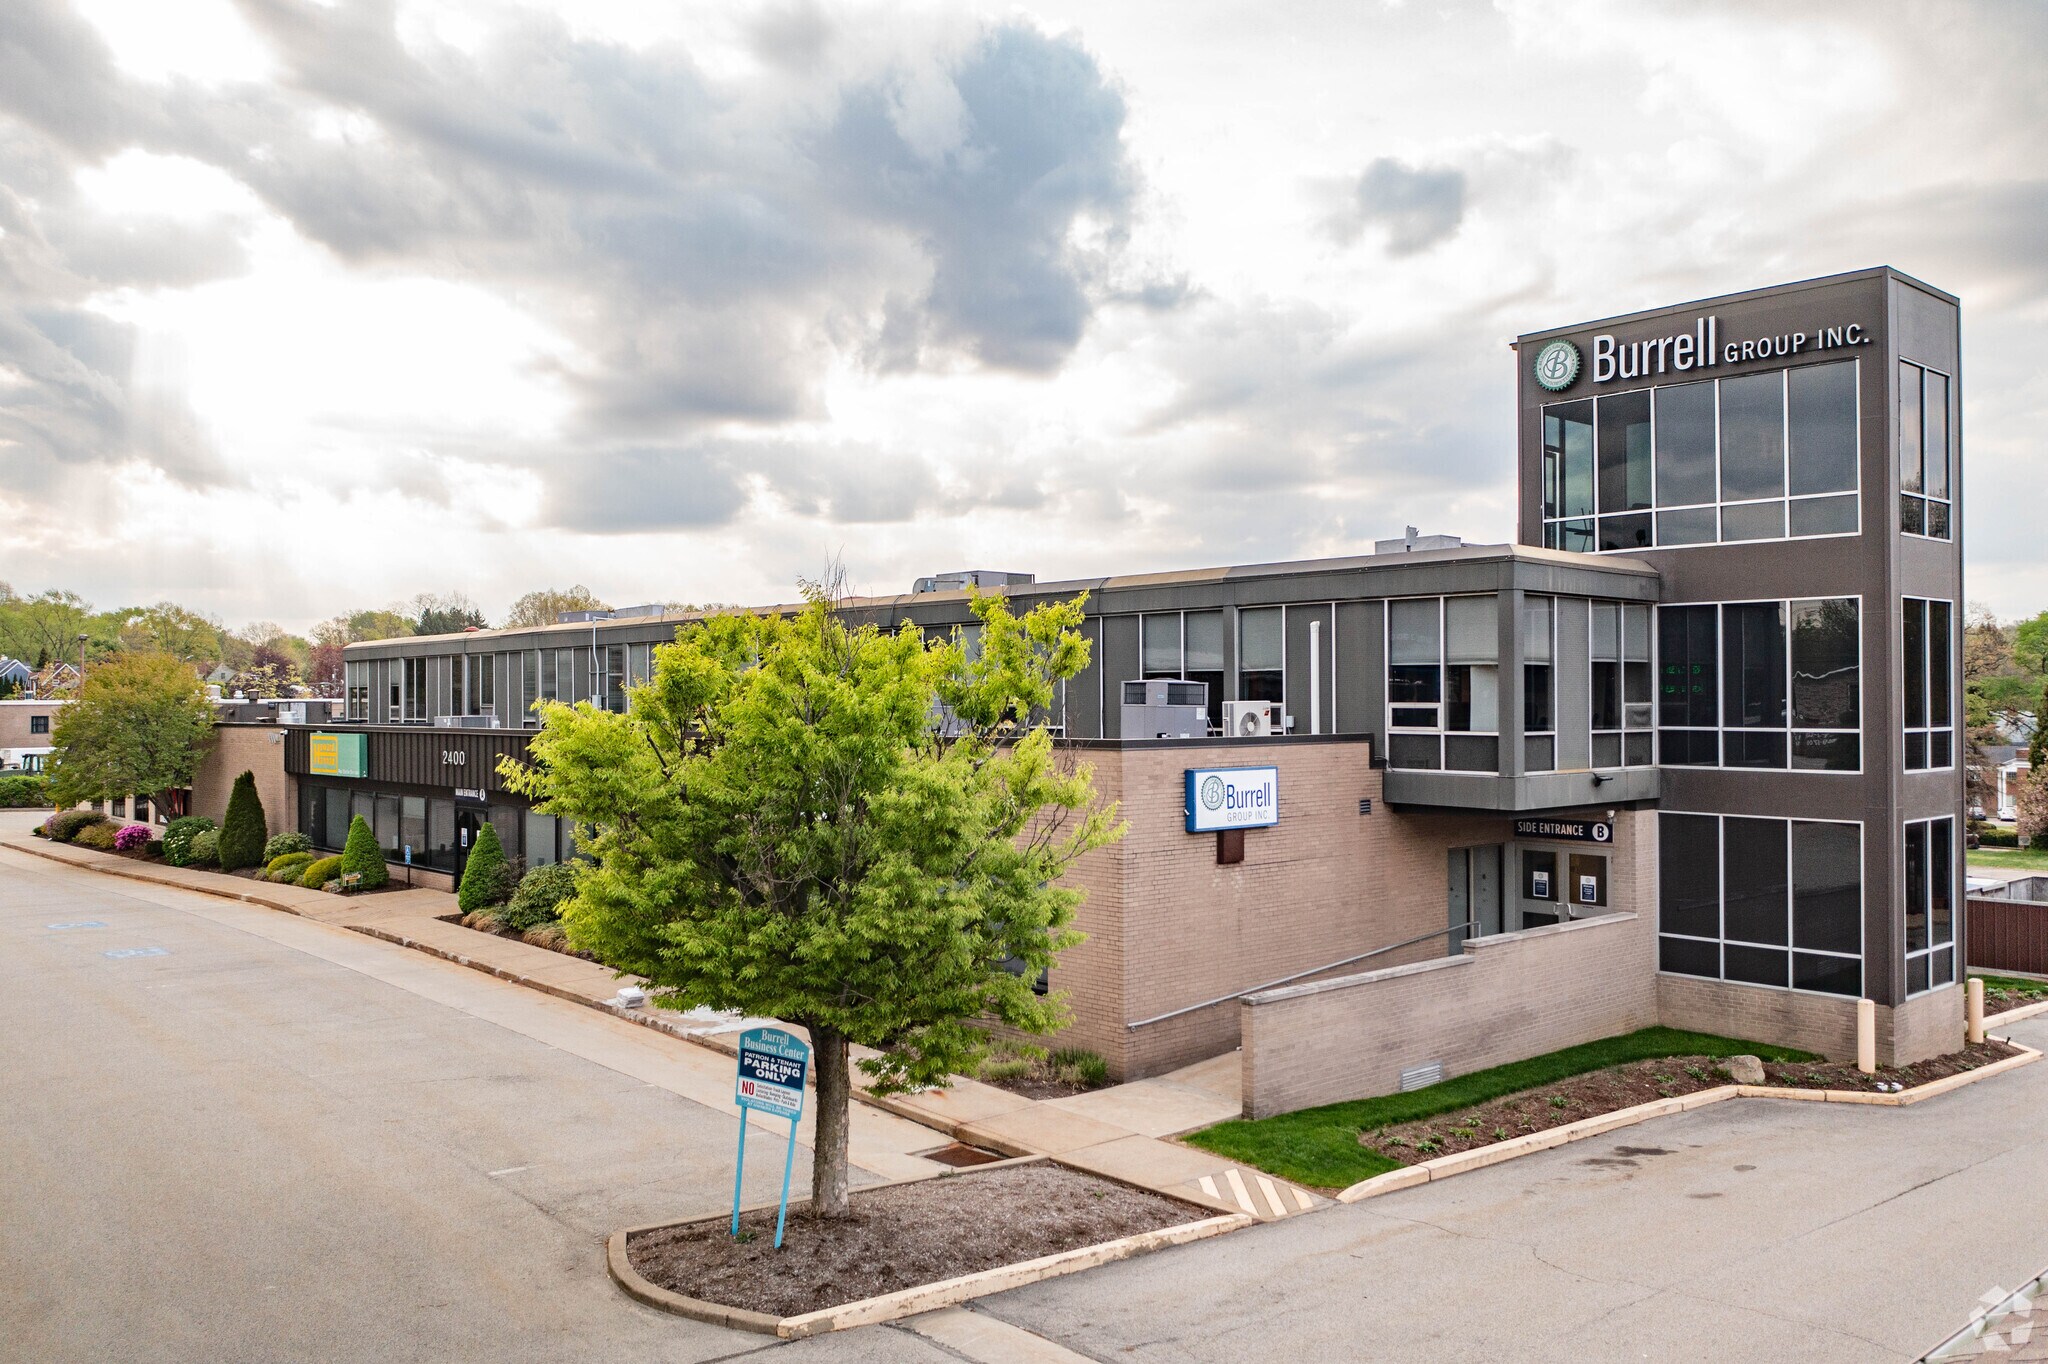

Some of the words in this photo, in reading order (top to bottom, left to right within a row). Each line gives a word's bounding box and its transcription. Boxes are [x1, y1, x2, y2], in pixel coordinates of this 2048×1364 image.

[1593, 315, 1716, 383] Burrell
[1724, 332, 1806, 363] GROUP
[1818, 323, 1870, 349] INC.
[442, 750, 465, 766] 2400
[463, 788, 479, 798] ENTRANCE
[1226, 782, 1271, 810] Burrell
[1227, 811, 1253, 822] GROUP
[1255, 810, 1270, 820] INC.
[1517, 821, 1537, 833] SIDE
[1539, 823, 1584, 836] ENTRANCE
[1596, 825, 1605, 839] B
[761, 1029, 790, 1045] Burrell
[744, 1036, 777, 1053] Business
[778, 1044, 804, 1060] Center
[743, 1057, 801, 1078] PARKING
[744, 1051, 770, 1062] PATRON
[777, 1058, 801, 1069] TENANT
[755, 1069, 788, 1083] ONLY
[741, 1080, 755, 1096] NO
